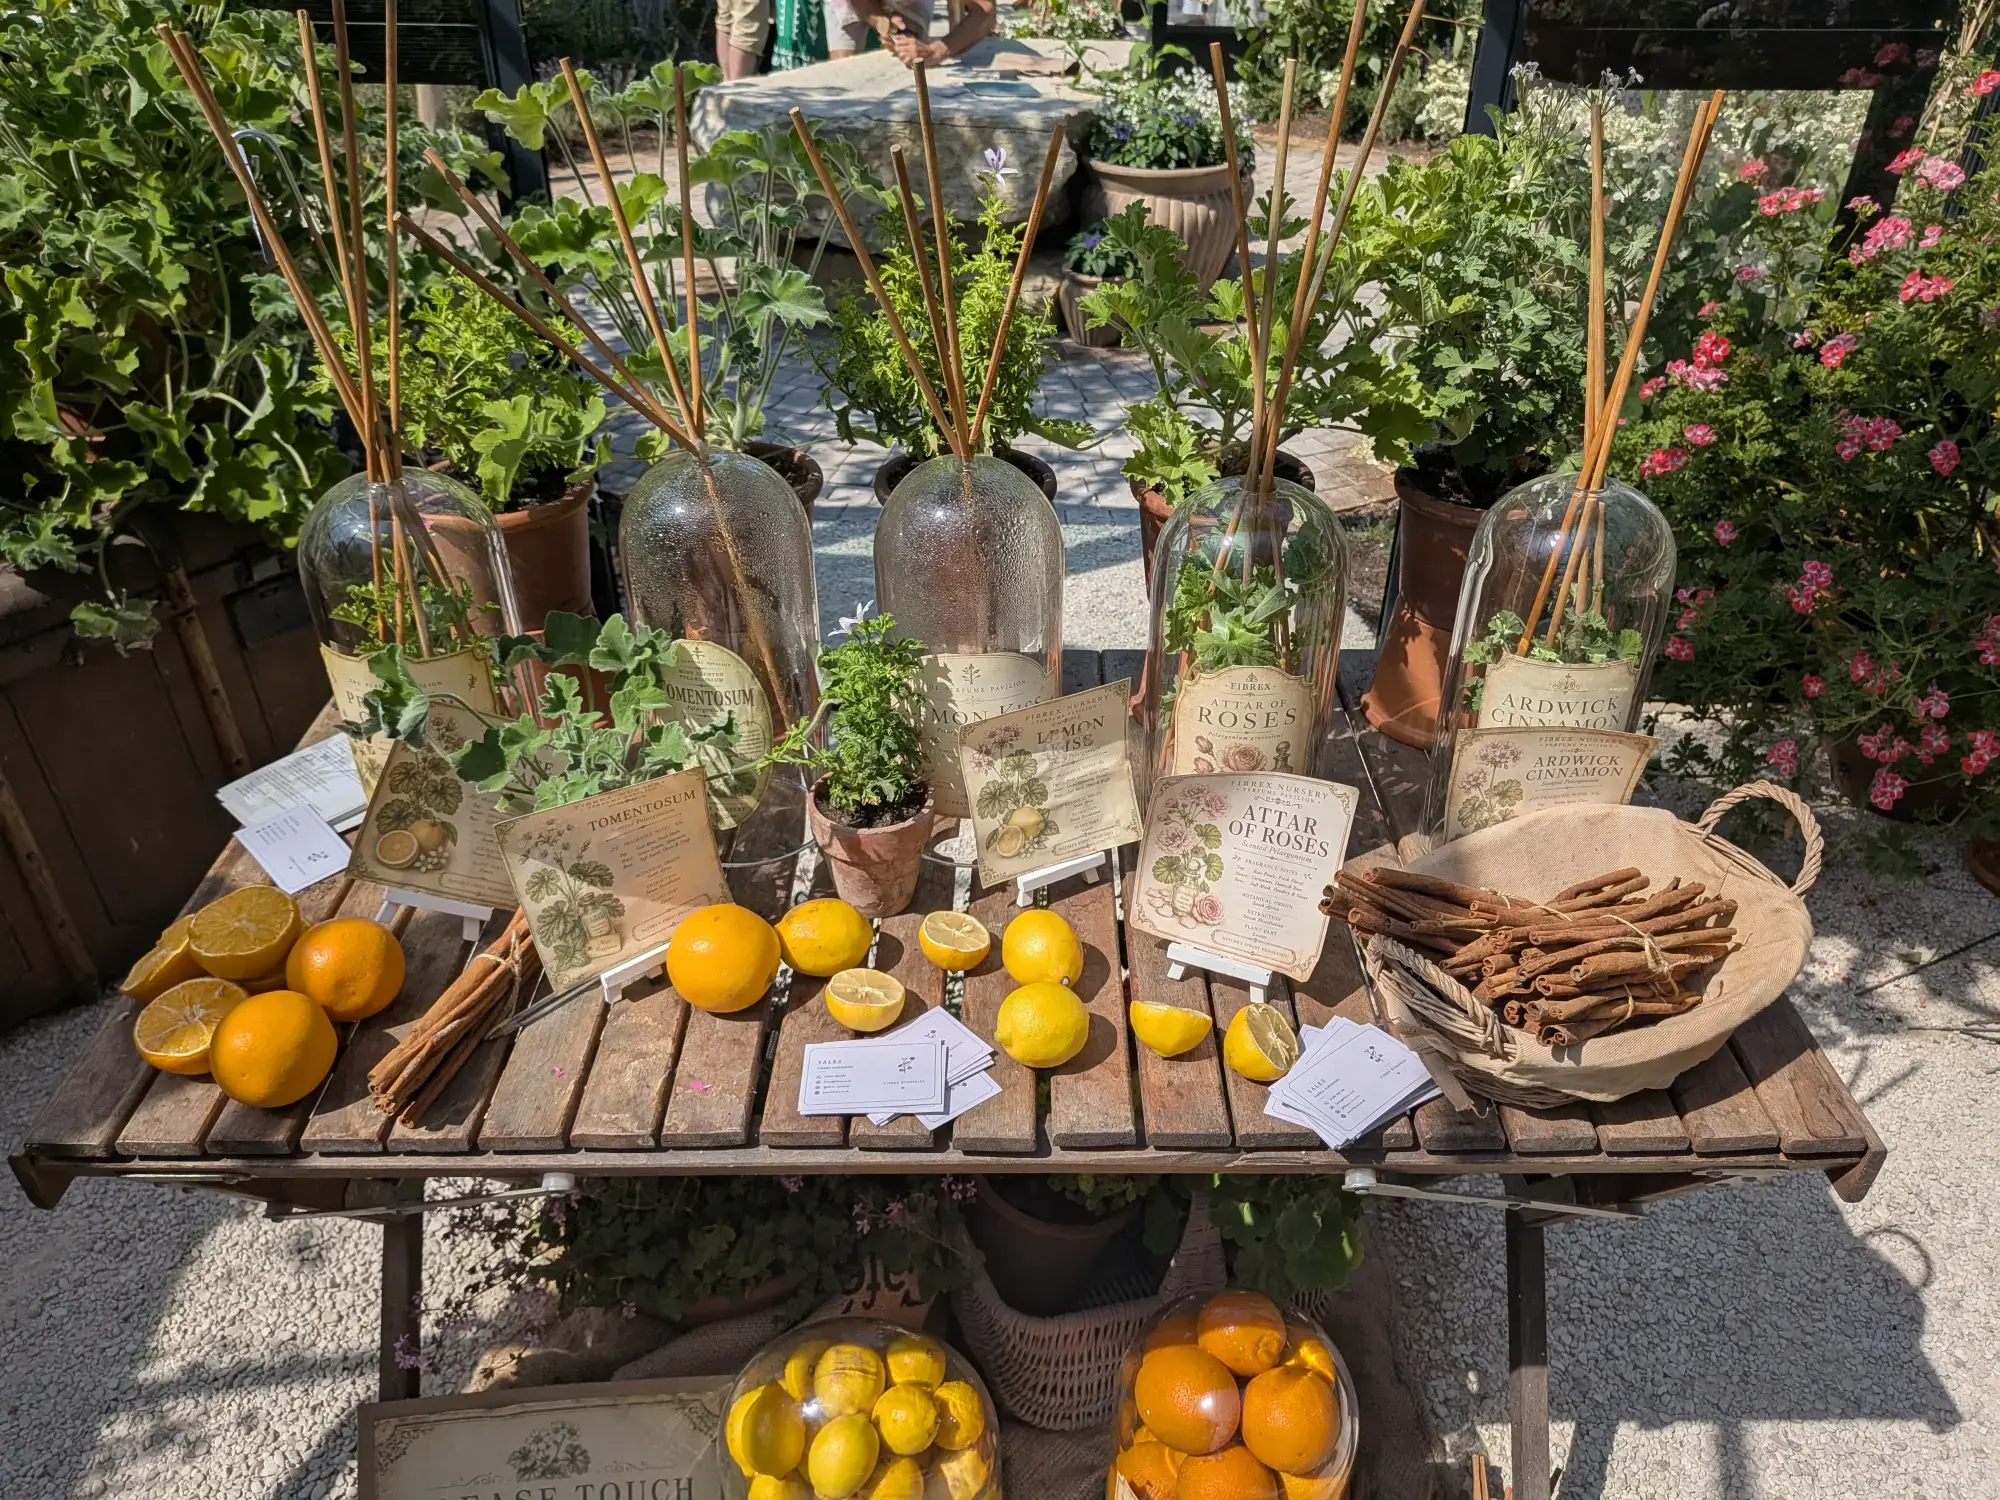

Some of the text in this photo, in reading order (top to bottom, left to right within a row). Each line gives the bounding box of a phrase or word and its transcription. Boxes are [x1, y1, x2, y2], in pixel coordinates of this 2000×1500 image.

[990, 679, 1026, 692] PAVILION
[1230, 682, 1272, 690] FIBREX
[1067, 694, 1109, 710] NURSERY
[1211, 698, 1287, 710] ATTAR OF
[1502, 693, 1620, 715] ARDWICK
[1198, 706, 1297, 730] ROSES
[1036, 716, 1105, 744] LEMON
[1208, 732, 1248, 740] Pelargonium
[1533, 756, 1621, 768] ARDWICK
[1526, 766, 1624, 780] CINNAMON
[1231, 780, 1328, 800] FIBREX NURSERY
[1242, 788, 1315, 804] PERFUME PAVILION
[588, 790, 697, 832] TOMENTOSUM
[1242, 804, 1317, 836] ATTAR
[1228, 820, 1330, 858] OF ROSES
[1242, 840, 1313, 864] Scented Pelargonium
[1245, 859, 1298, 876] FRAGRANCE NOTES
[1242, 892, 1272, 904] BOTANICAL
[1244, 924, 1262, 932] PLANT
[1307, 1078, 1326, 1094] SALES
[575, 1477, 695, 1500] TOUCH
